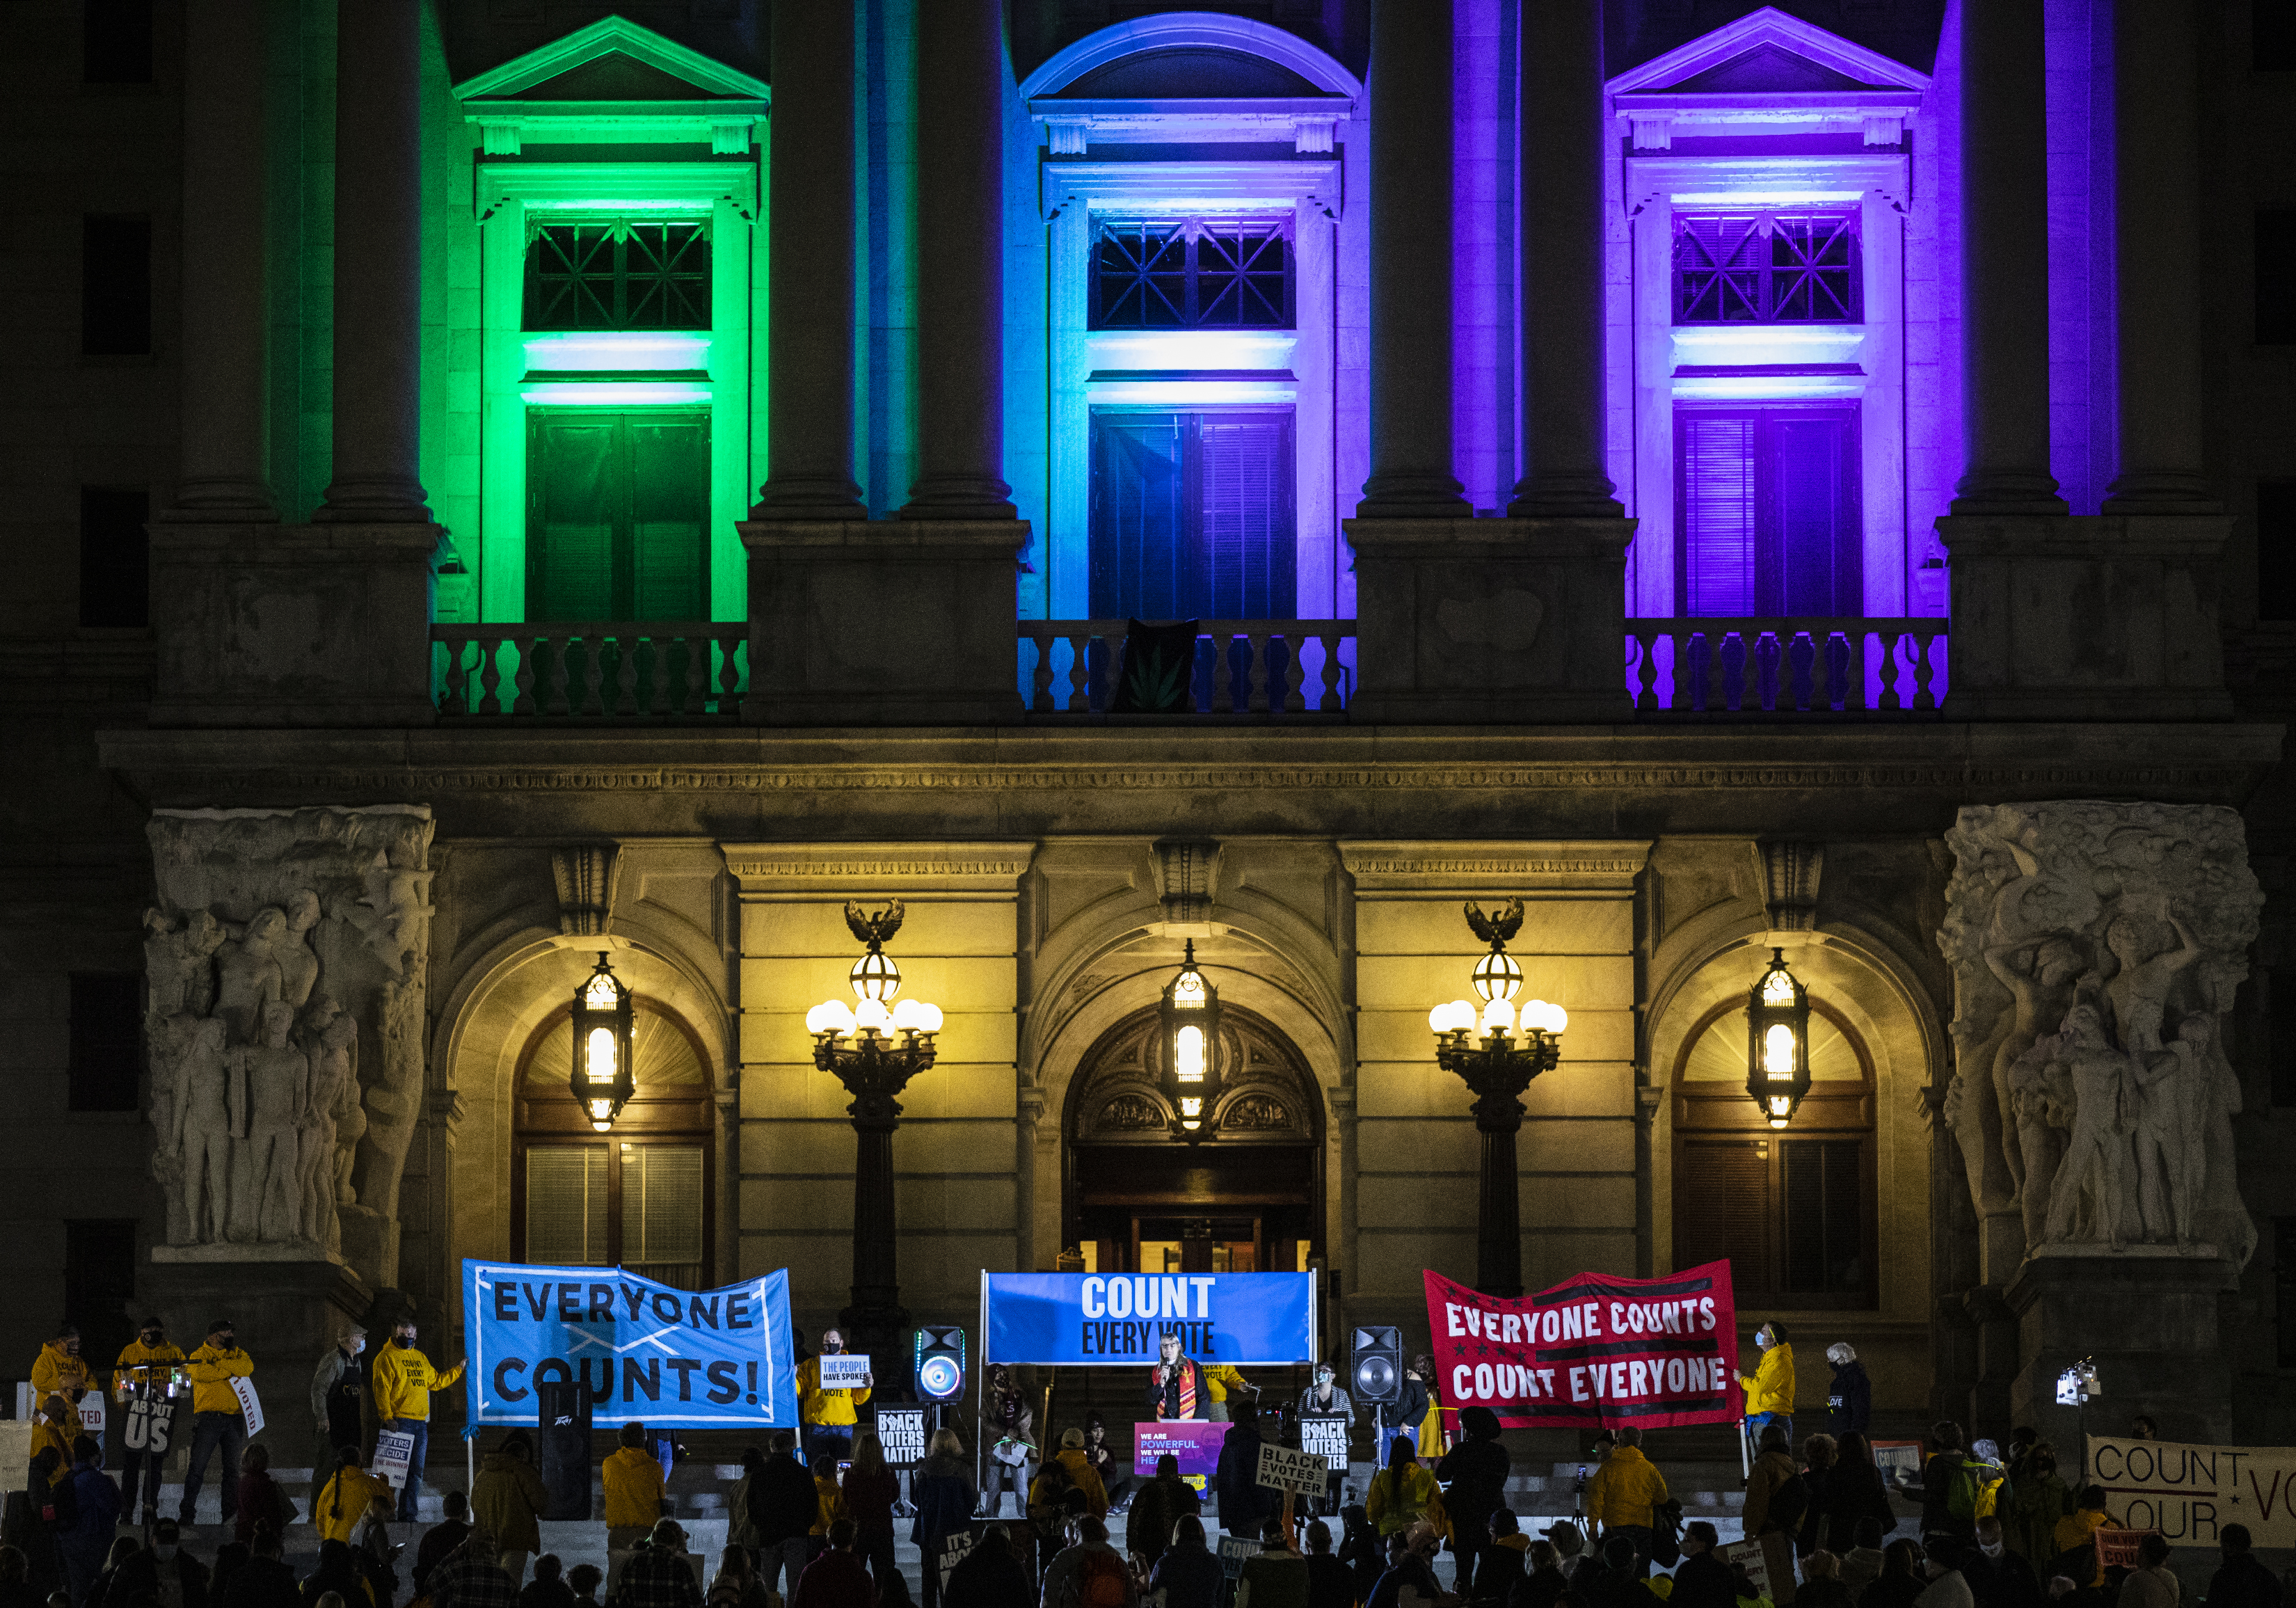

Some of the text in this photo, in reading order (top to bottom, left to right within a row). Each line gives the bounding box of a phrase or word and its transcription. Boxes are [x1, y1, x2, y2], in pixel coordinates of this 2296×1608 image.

[1082, 1276, 1215, 1319] COUNT
[495, 1282, 753, 1330] EVERYONE
[1446, 1296, 1716, 1344] EVERYONE COUNTS
[1082, 1321, 1151, 1354] EVERY
[401, 1360, 422, 1368] COUNT
[823, 1361, 867, 1372] THE PEOPLE
[406, 1369, 424, 1377] EVERY
[493, 1357, 758, 1405] COUNTS!
[1453, 1357, 1726, 1402] COUNT EVERYONE
[410, 1379, 426, 1387] VOTE
[824, 1389, 843, 1397] VOTE
[238, 1386, 255, 1431] VOTED
[80, 1410, 101, 1424] TED
[125, 1412, 170, 1453] US
[878, 1431, 925, 1447] VOTERS
[378, 1435, 409, 1448] VOTERS
[1140, 1440, 1199, 1449] POWERFUL.
[1302, 1439, 1347, 1454] VOTERS
[385, 1460, 408, 1469] WINNER
[1263, 1447, 1323, 1471] BLACK
[2096, 1444, 2249, 1486] COUNT
[1270, 1463, 1315, 1480] VOTES
[1260, 1473, 1321, 1493] MATTER
[2127, 1499, 2217, 1541] OUR
[946, 1530, 972, 1551] IT'S
[2101, 1534, 2140, 1545] OUR VOT
[1730, 1549, 1761, 1563] COUNT
[2105, 1550, 2135, 1564] COU
[1746, 1566, 1764, 1577] ERY
